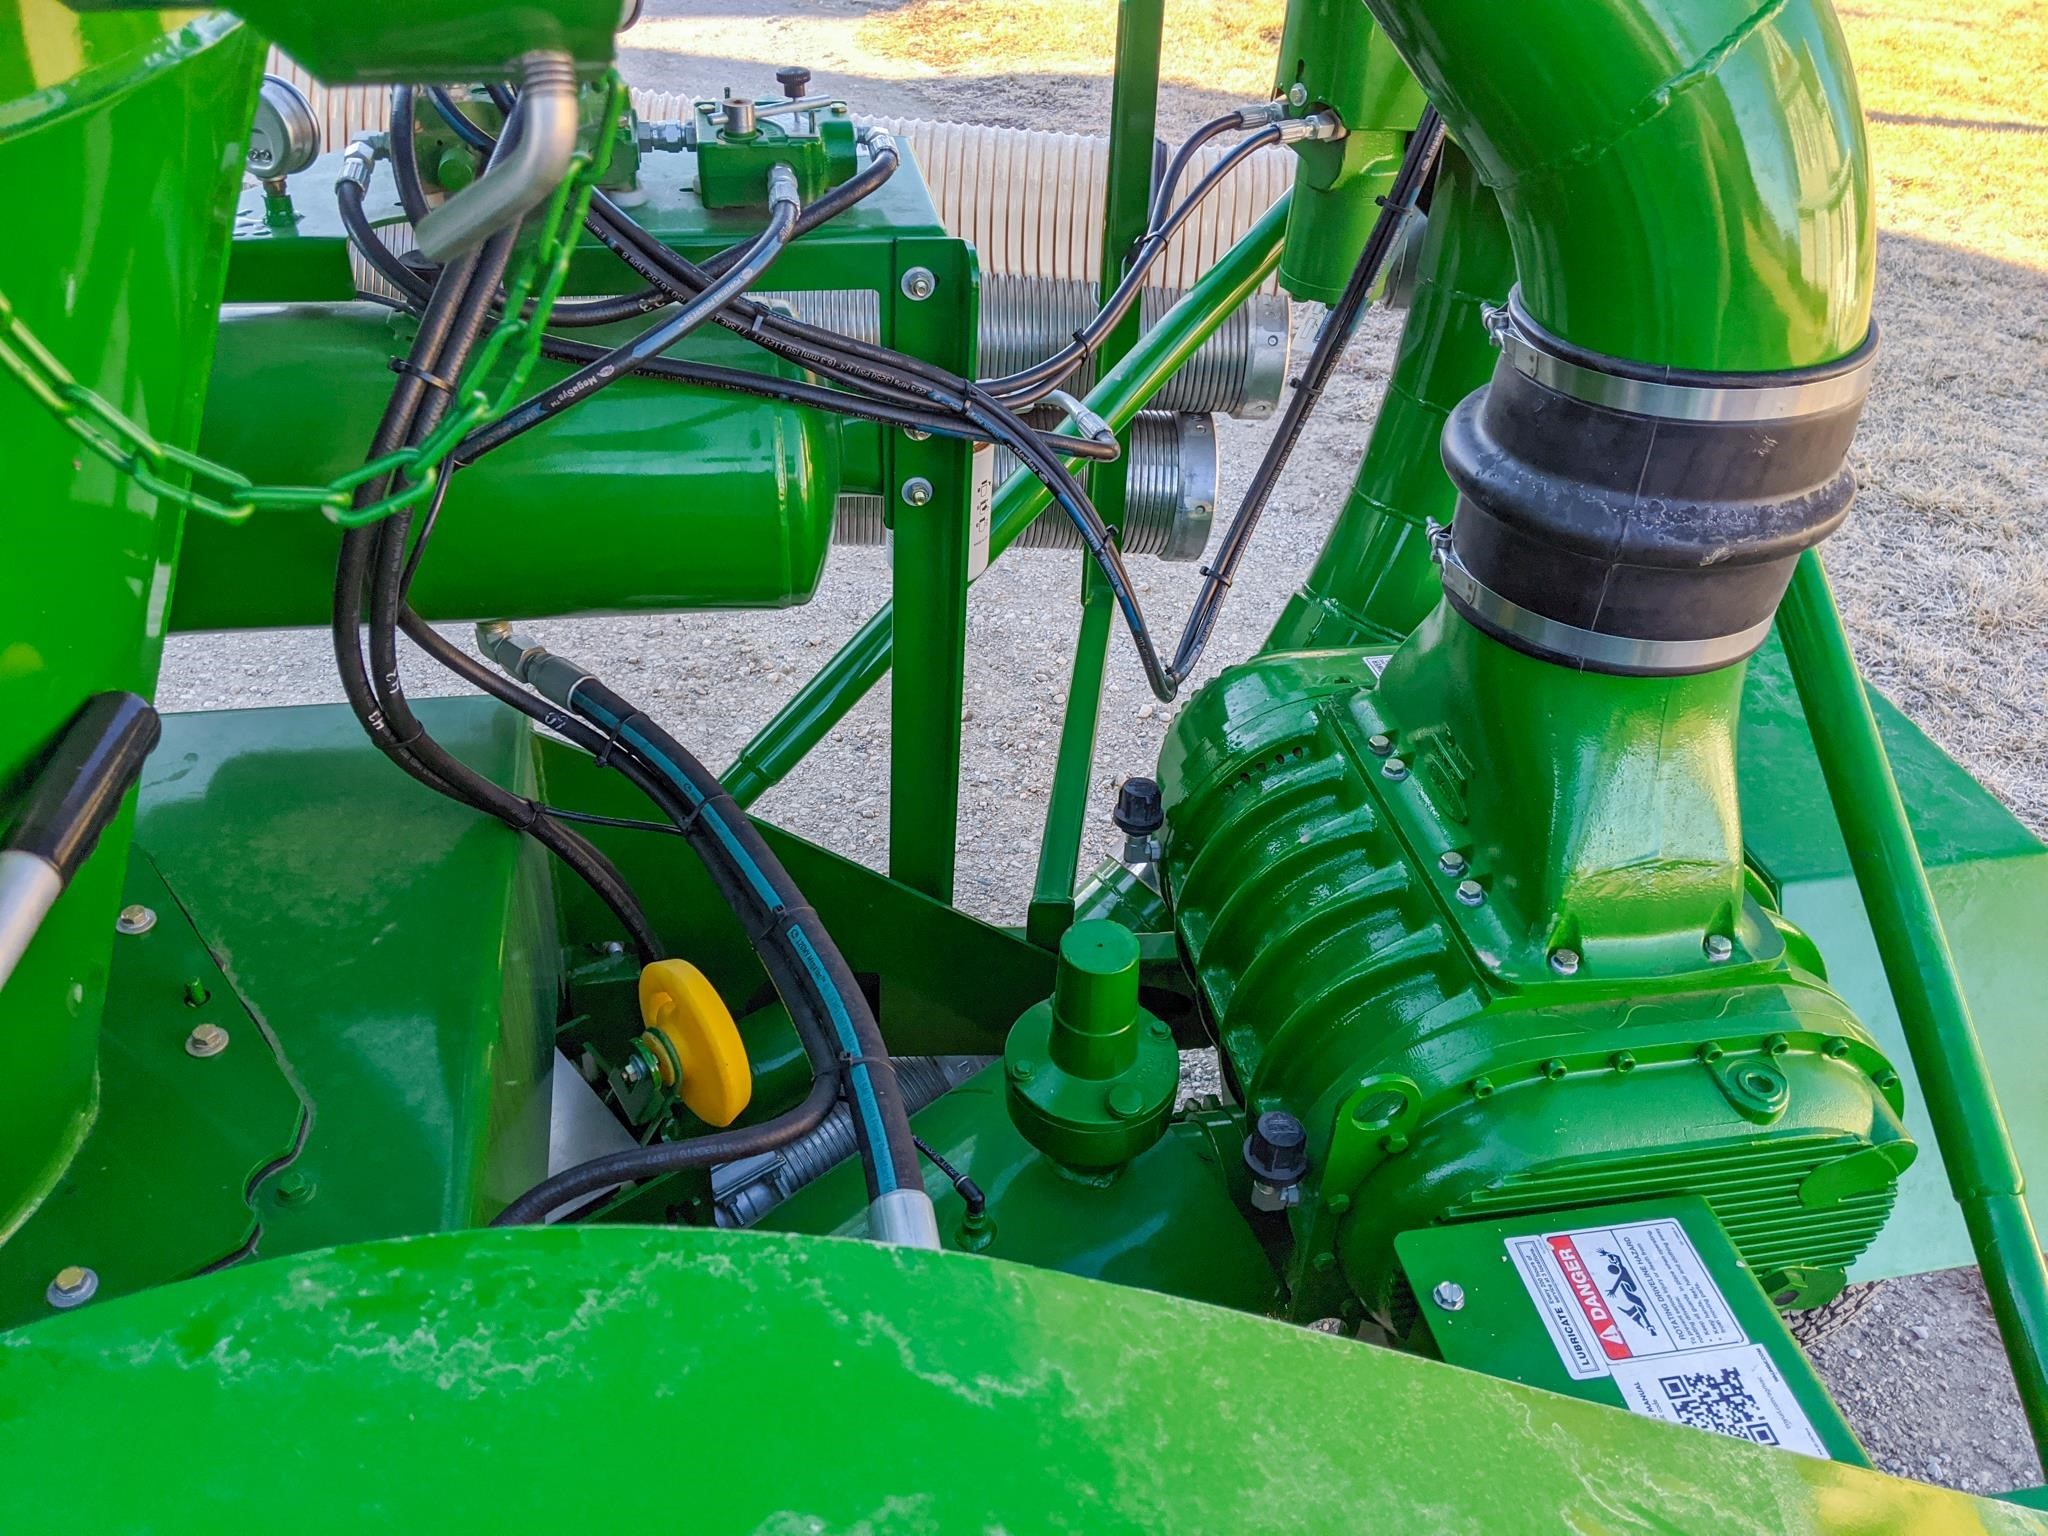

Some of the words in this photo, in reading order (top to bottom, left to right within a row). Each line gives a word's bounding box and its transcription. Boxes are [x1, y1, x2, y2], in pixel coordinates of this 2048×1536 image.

[1622, 1236, 1643, 1264] HAZARD
[1635, 1242, 1646, 1255] from
[1662, 1242, 1678, 1263] clothing
[1529, 1261, 1541, 1276] hours
[1643, 1256, 1656, 1271] death
[1660, 1255, 1672, 1269] when
[1675, 1264, 1684, 1274] and
[1536, 1277, 1546, 1287] 200
[1556, 1248, 1608, 1320] DANGER
[1639, 1266, 1664, 1301] DRIVELINE
[1656, 1278, 1669, 1293] injury
[1669, 1270, 1681, 1285] place
[1682, 1275, 1691, 1285] hair
[1542, 1288, 1555, 1303] Every
[1547, 1283, 1560, 1302] service
[1682, 1293, 1697, 1312] guards
[1702, 1298, 1718, 1318] moving
[1660, 1303, 1686, 1339] ROTATING
[1677, 1315, 1693, 1335] prevent
[1697, 1320, 1710, 1335] Keep
[1706, 1319, 1720, 1334] Keep
[1552, 1307, 1591, 1365] LUBRICATE
[1688, 1321, 1705, 1343] rotating
[1633, 1382, 1654, 1412] MANUAL
